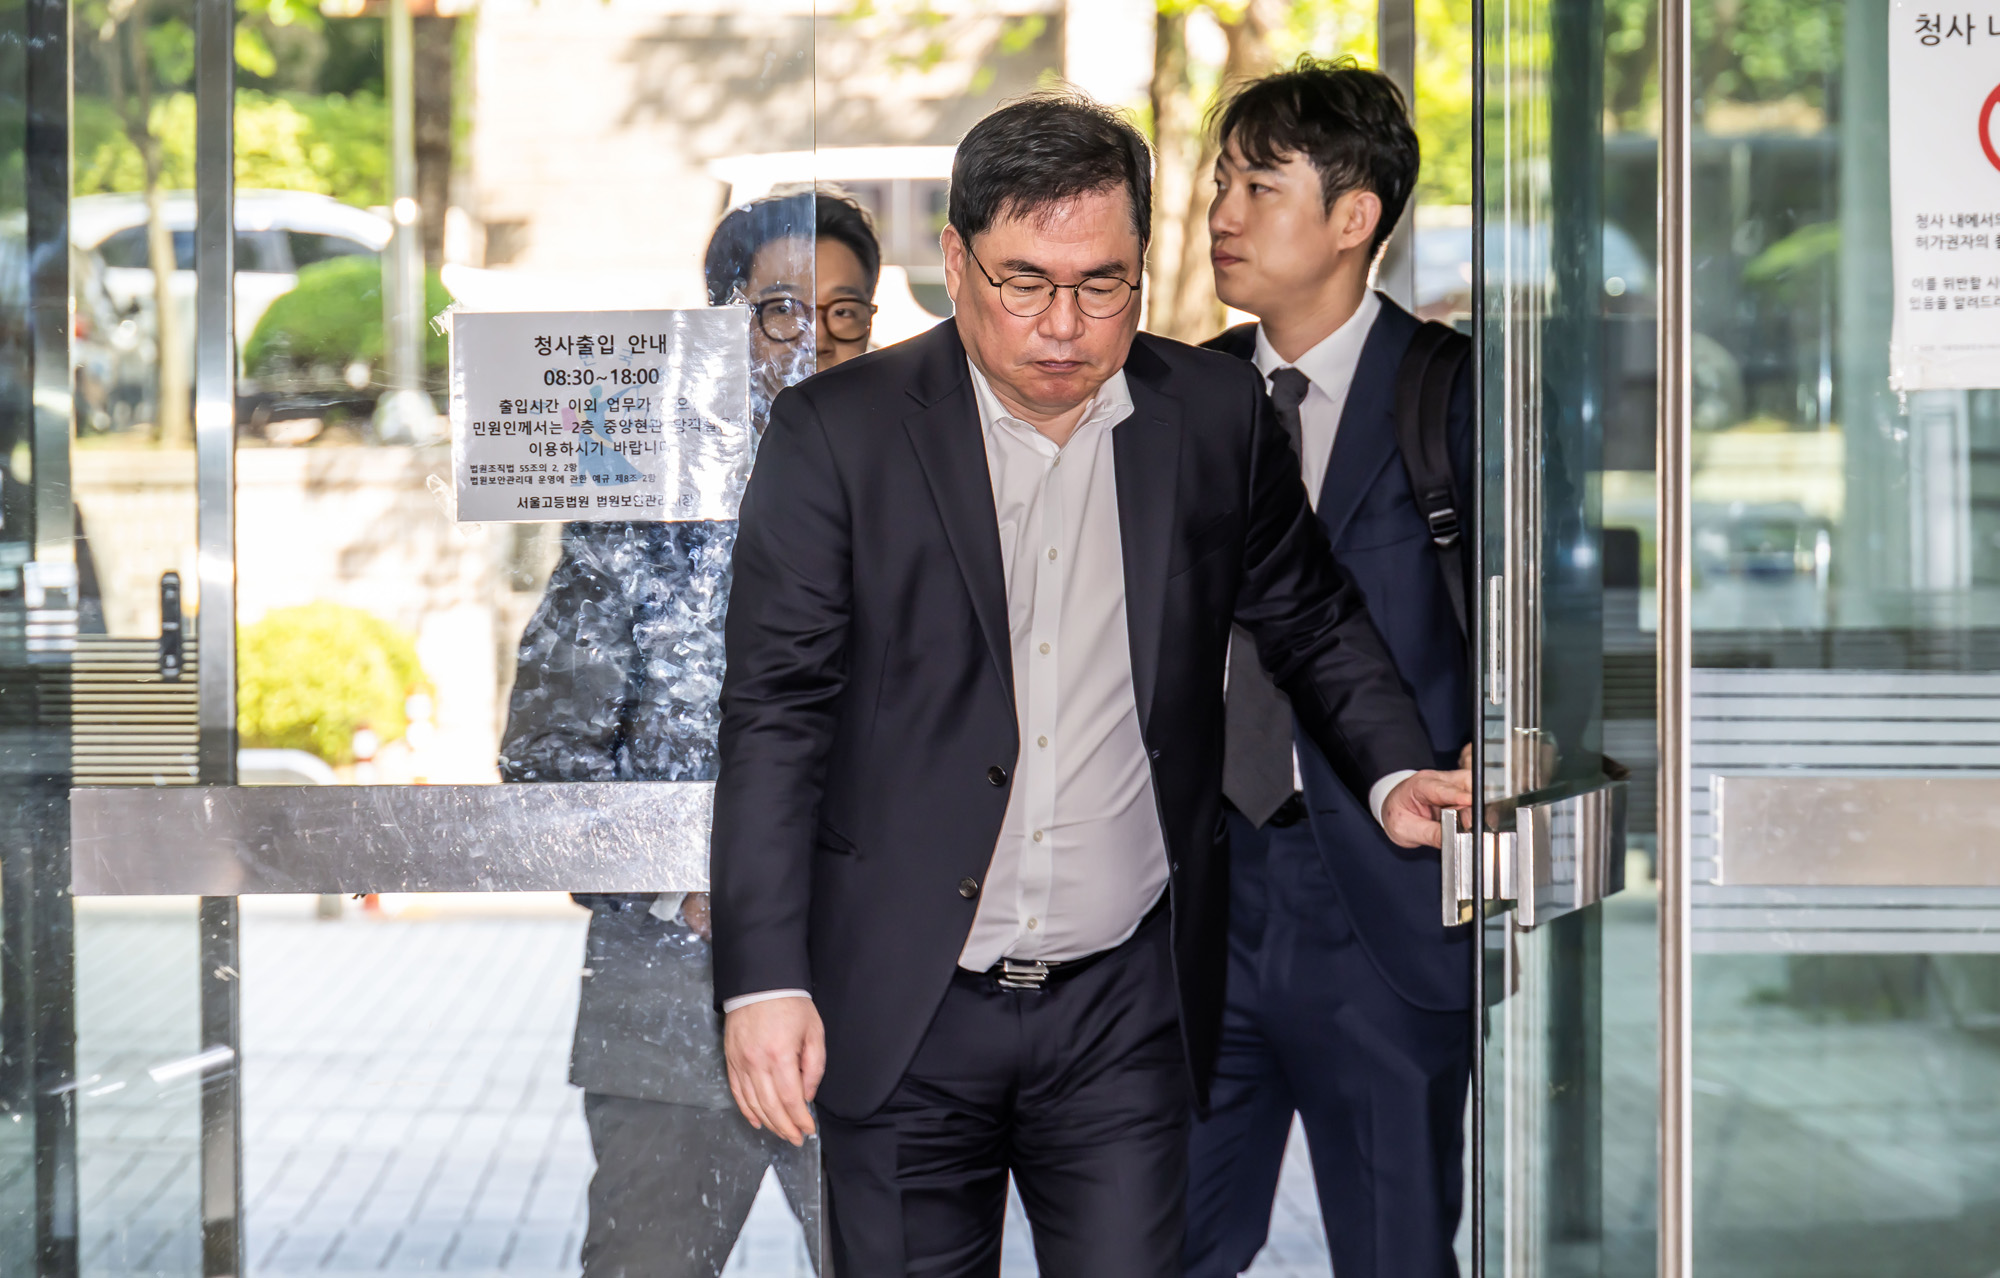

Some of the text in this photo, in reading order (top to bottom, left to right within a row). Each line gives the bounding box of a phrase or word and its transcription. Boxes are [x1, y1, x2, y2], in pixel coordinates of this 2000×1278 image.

[1915, 13, 1976, 46] 청사
[1915, 212, 1944, 229] 청사
[534, 333, 667, 356] 청사출입 안내
[543, 368, 660, 386] 08:30~18:00
[499, 398, 560, 414] 출입시간
[568, 397, 597, 413] 이외
[606, 397, 651, 413] 업무가
[473, 420, 563, 436] 민원인께서는
[571, 419, 595, 434] 2층
[603, 418, 662, 434] 중앙현관
[529, 441, 604, 457] 이용하시기
[469, 463, 515, 474] 법원조직법
[519, 463, 547, 473] 55조의
[563, 462, 578, 473] 2항
[469, 475, 533, 486] 법원보안관리대
[537, 474, 565, 484] 운영에
[569, 474, 587, 484] 관한
[592, 474, 610, 483] 예규
[517, 496, 590, 509] 서울고등법원
